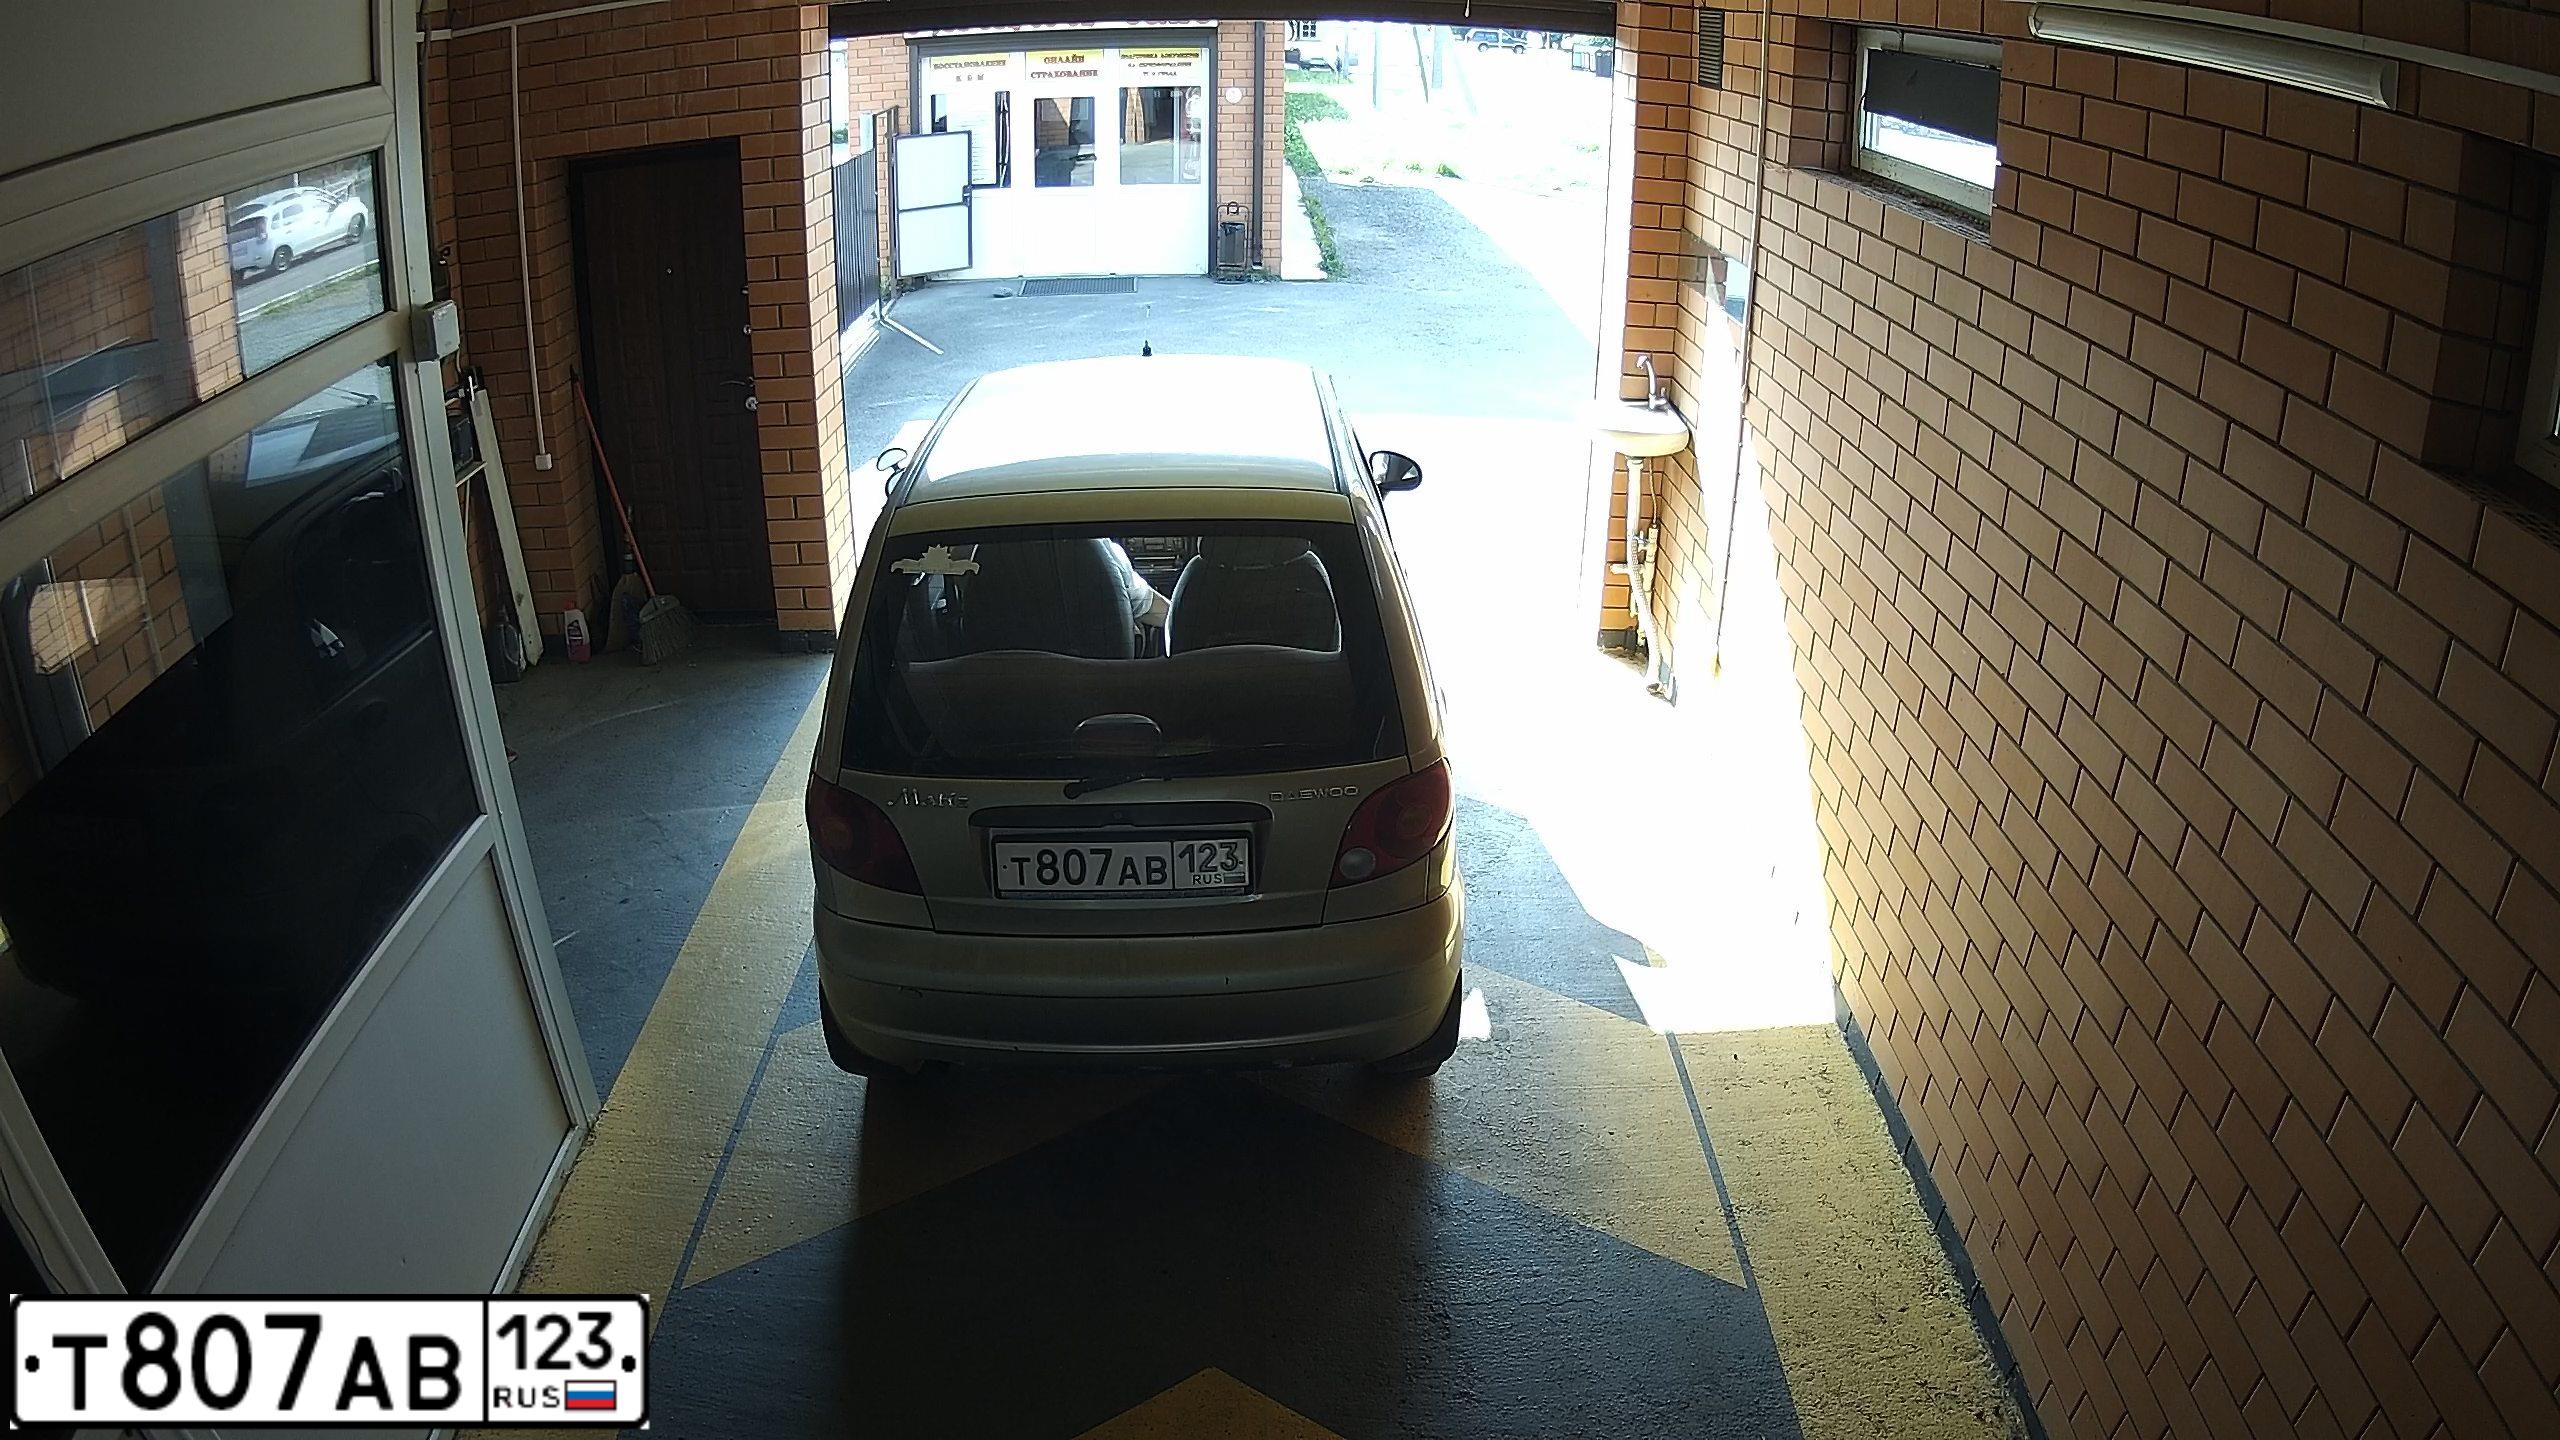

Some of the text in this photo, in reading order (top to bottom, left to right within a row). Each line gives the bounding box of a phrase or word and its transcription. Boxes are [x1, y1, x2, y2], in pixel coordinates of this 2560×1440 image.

[1043, 53, 1085, 64] ОНЛАЙН
[1030, 69, 1098, 79] СТРАХОВАНИЕ
[1270, 785, 1359, 801] DAEWOO
[1178, 841, 1239, 873] 123
[1192, 873, 1222, 886] RUS
